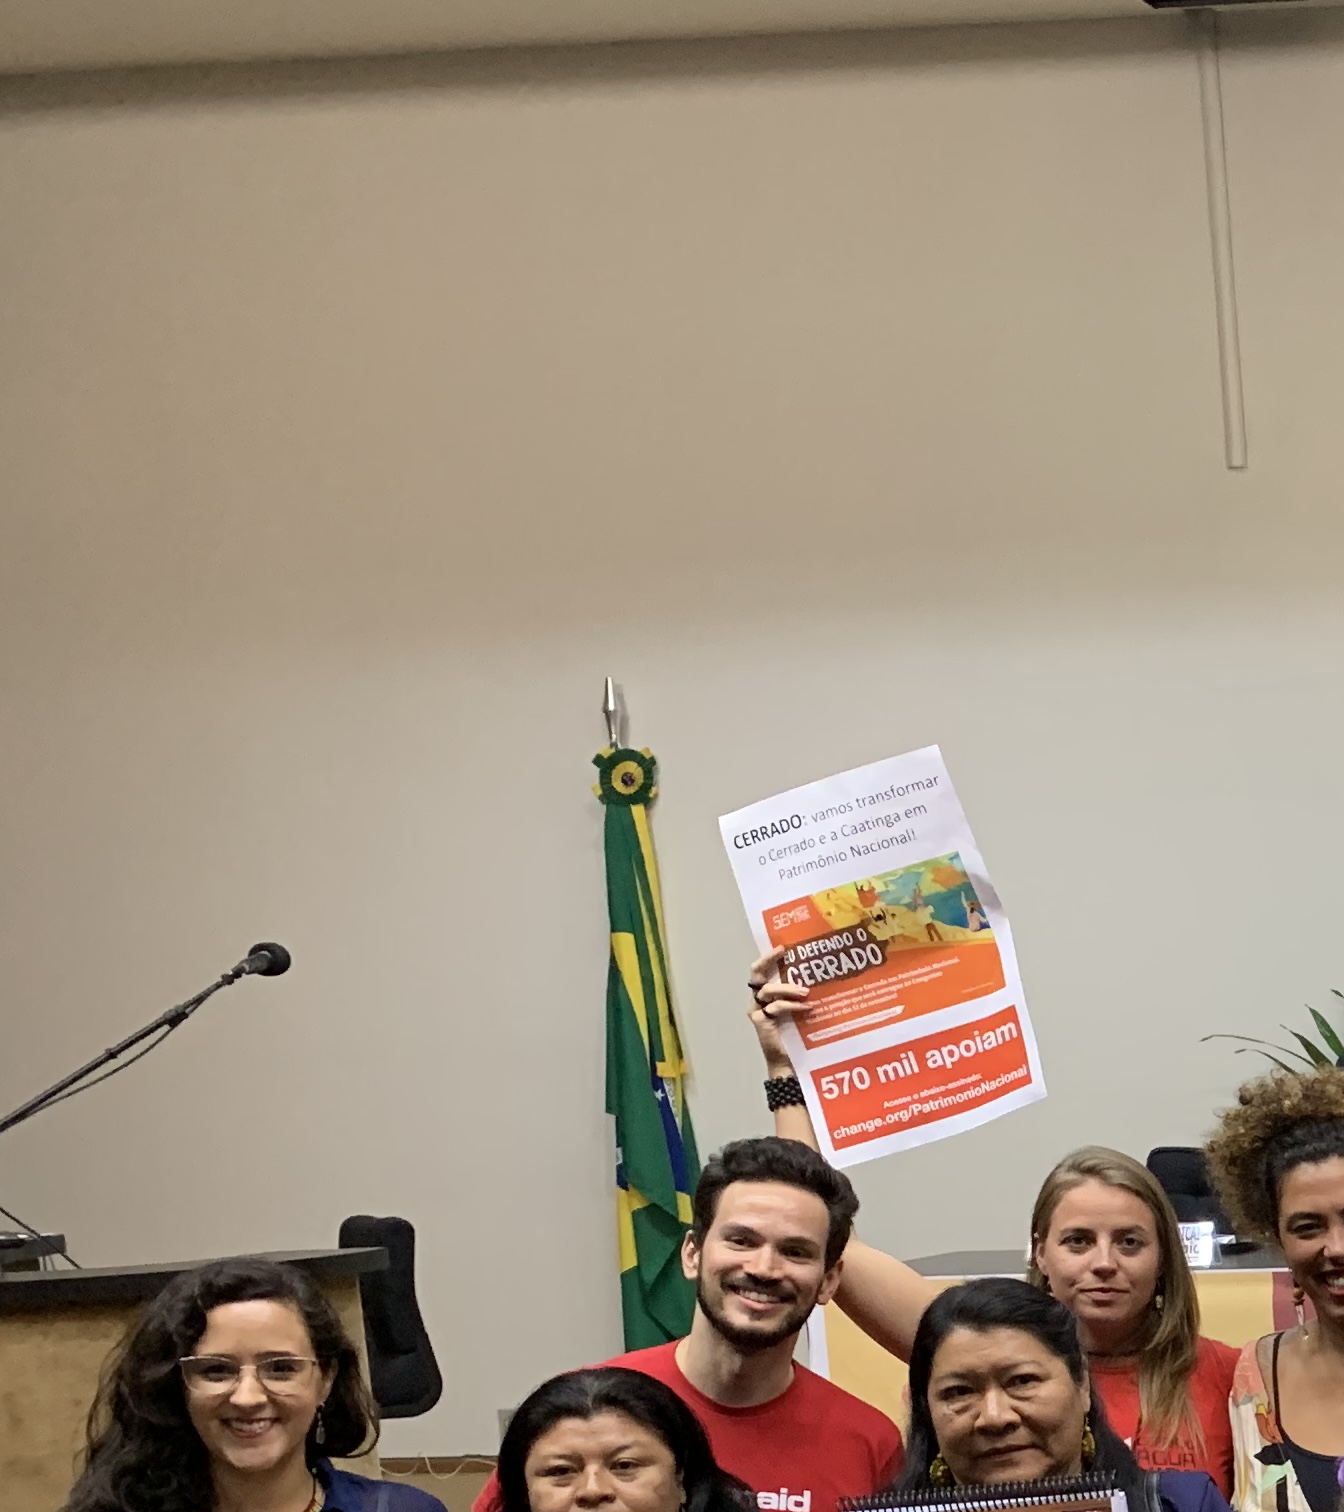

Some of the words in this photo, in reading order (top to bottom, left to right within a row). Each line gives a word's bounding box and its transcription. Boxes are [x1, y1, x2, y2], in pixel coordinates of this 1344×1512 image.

[734, 814, 808, 849] CERRADO:
[811, 801, 854, 823] vamos
[855, 776, 939, 808] transformar
[759, 855, 766, 866] o
[769, 837, 815, 862] Cerrado
[819, 834, 826, 845] e
[831, 830, 838, 841] a
[841, 811, 901, 838] Caatinga
[905, 803, 927, 819] em
[779, 852, 848, 880] Patrimônio
[850, 828, 917, 858] Nacional!
[787, 943, 882, 988] CERRADO
[797, 932, 853, 960] DEFENDO
[857, 928, 867, 941] O
[820, 1067, 870, 1100] 570
[877, 1051, 919, 1084] mil
[925, 1021, 1018, 1069] apoiam
[833, 1064, 1027, 1140] change.org/PatrimonioNacional
[757, 1487, 811, 1512] aid
